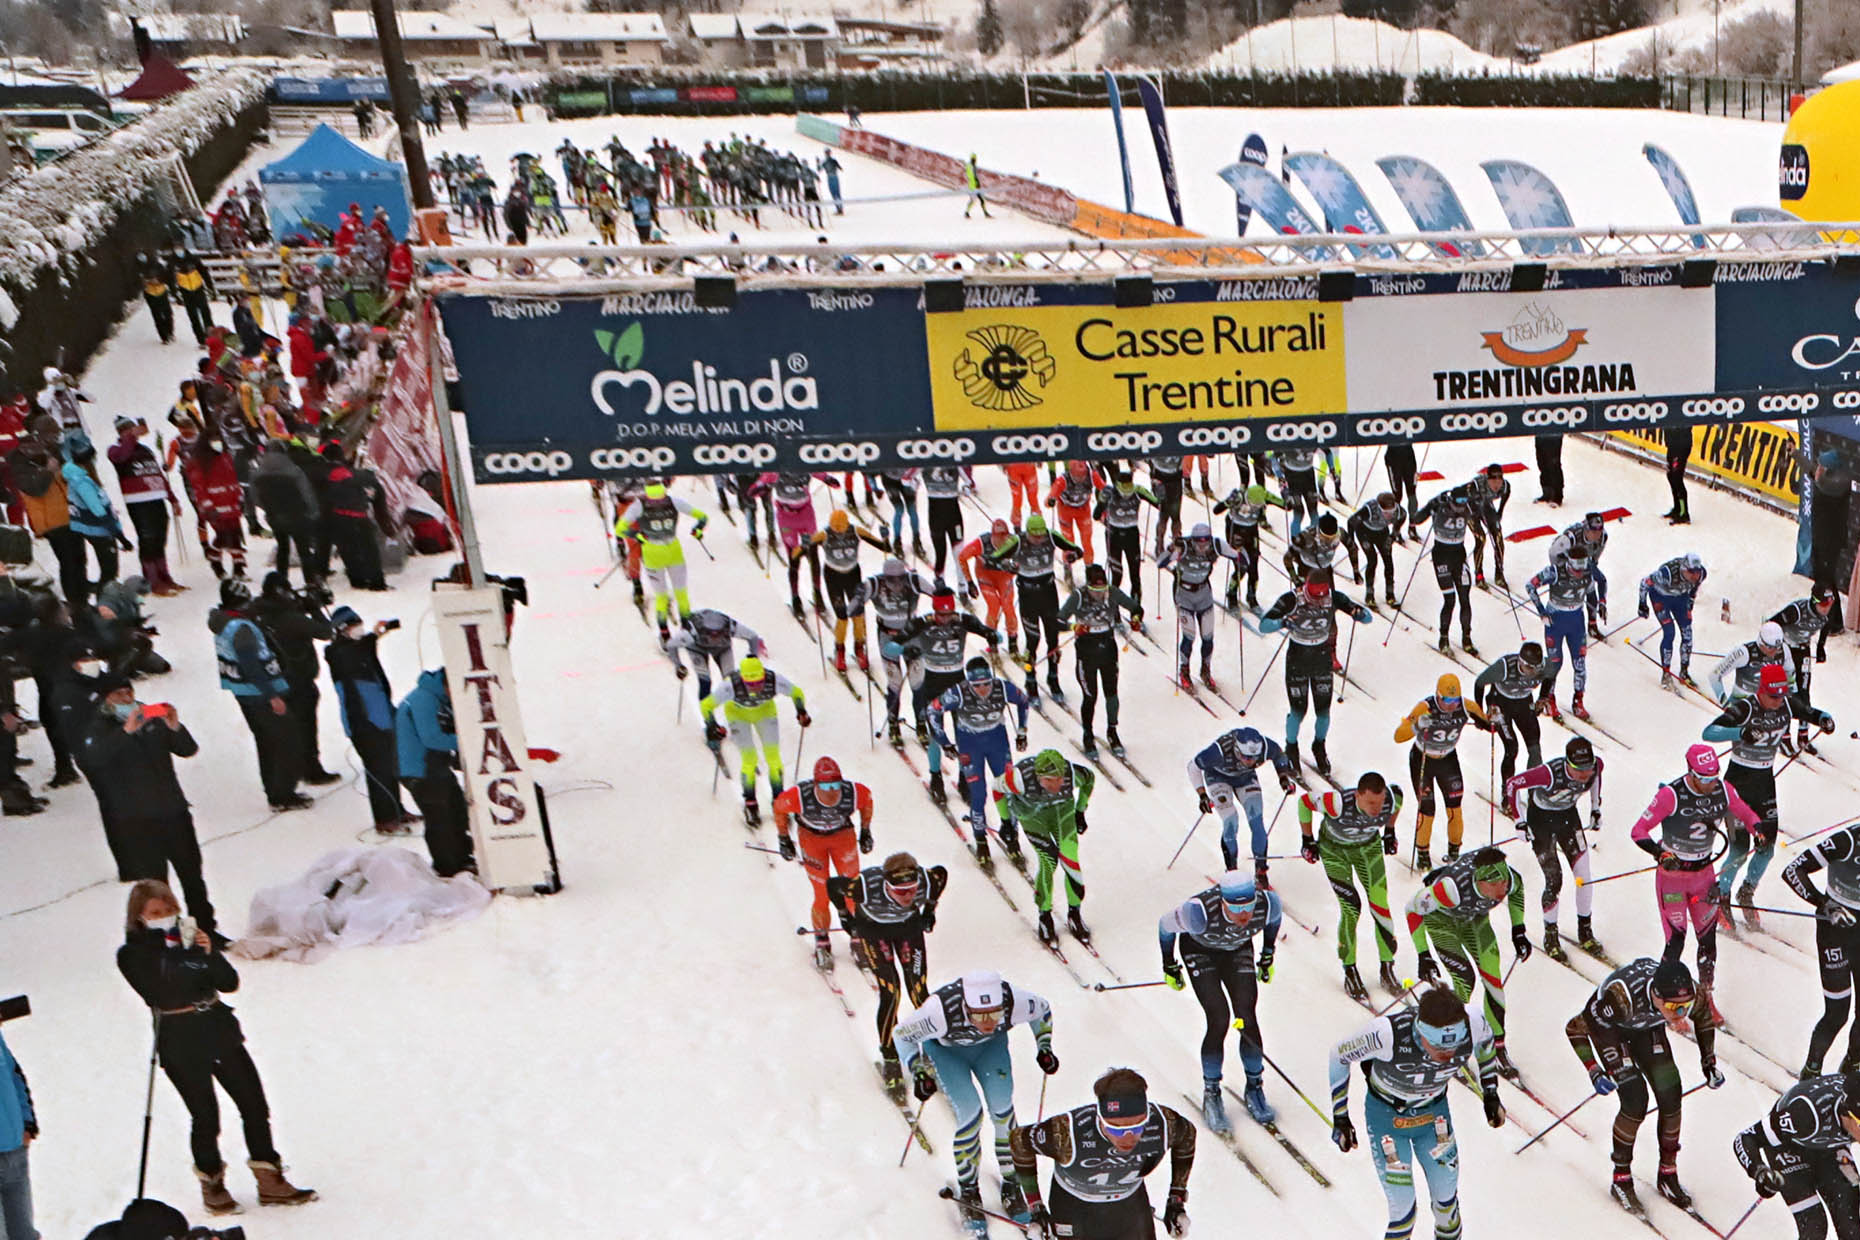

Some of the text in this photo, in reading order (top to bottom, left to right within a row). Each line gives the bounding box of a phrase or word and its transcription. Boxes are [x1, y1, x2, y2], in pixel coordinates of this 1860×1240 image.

[1369, 277, 1426, 297] TRENTINO
[1619, 267, 1673, 287] TRENTINO
[488, 300, 561, 319] TRENTINO
[806, 292, 874, 312] TRENTINO
[1075, 311, 1326, 362] Casse Rurali
[591, 358, 819, 416] Melinda
[1113, 369, 1295, 413] Trentine
[1432, 362, 1637, 401] TRENTINGRANA
[1603, 401, 1669, 424] coop
[1681, 397, 1745, 419] coop
[1758, 392, 1820, 414] coop
[664, 420, 707, 437] MELA
[711, 421, 739, 436] VAL
[744, 420, 761, 434] DI
[764, 418, 804, 434] NON
[1355, 416, 1426, 439] coop
[1440, 411, 1508, 433] coop
[1522, 405, 1588, 428] coop
[1087, 430, 1163, 453] coop
[1178, 425, 1251, 449] coop
[1266, 420, 1338, 443] coop
[693, 442, 777, 468] coop
[799, 442, 880, 467] coop
[896, 438, 976, 462] coop
[991, 433, 1069, 457] coop
[484, 450, 573, 477] coop
[590, 446, 676, 472] coop
[931, 639, 961, 654] 45
[460, 623, 526, 826] ITAS
[1750, 714, 1790, 727] CAVIT
[1433, 727, 1458, 742] 36
[1679, 804, 1725, 818] CAVIT
[1824, 947, 1844, 962] 157
[1778, 1111, 1797, 1134] 157
